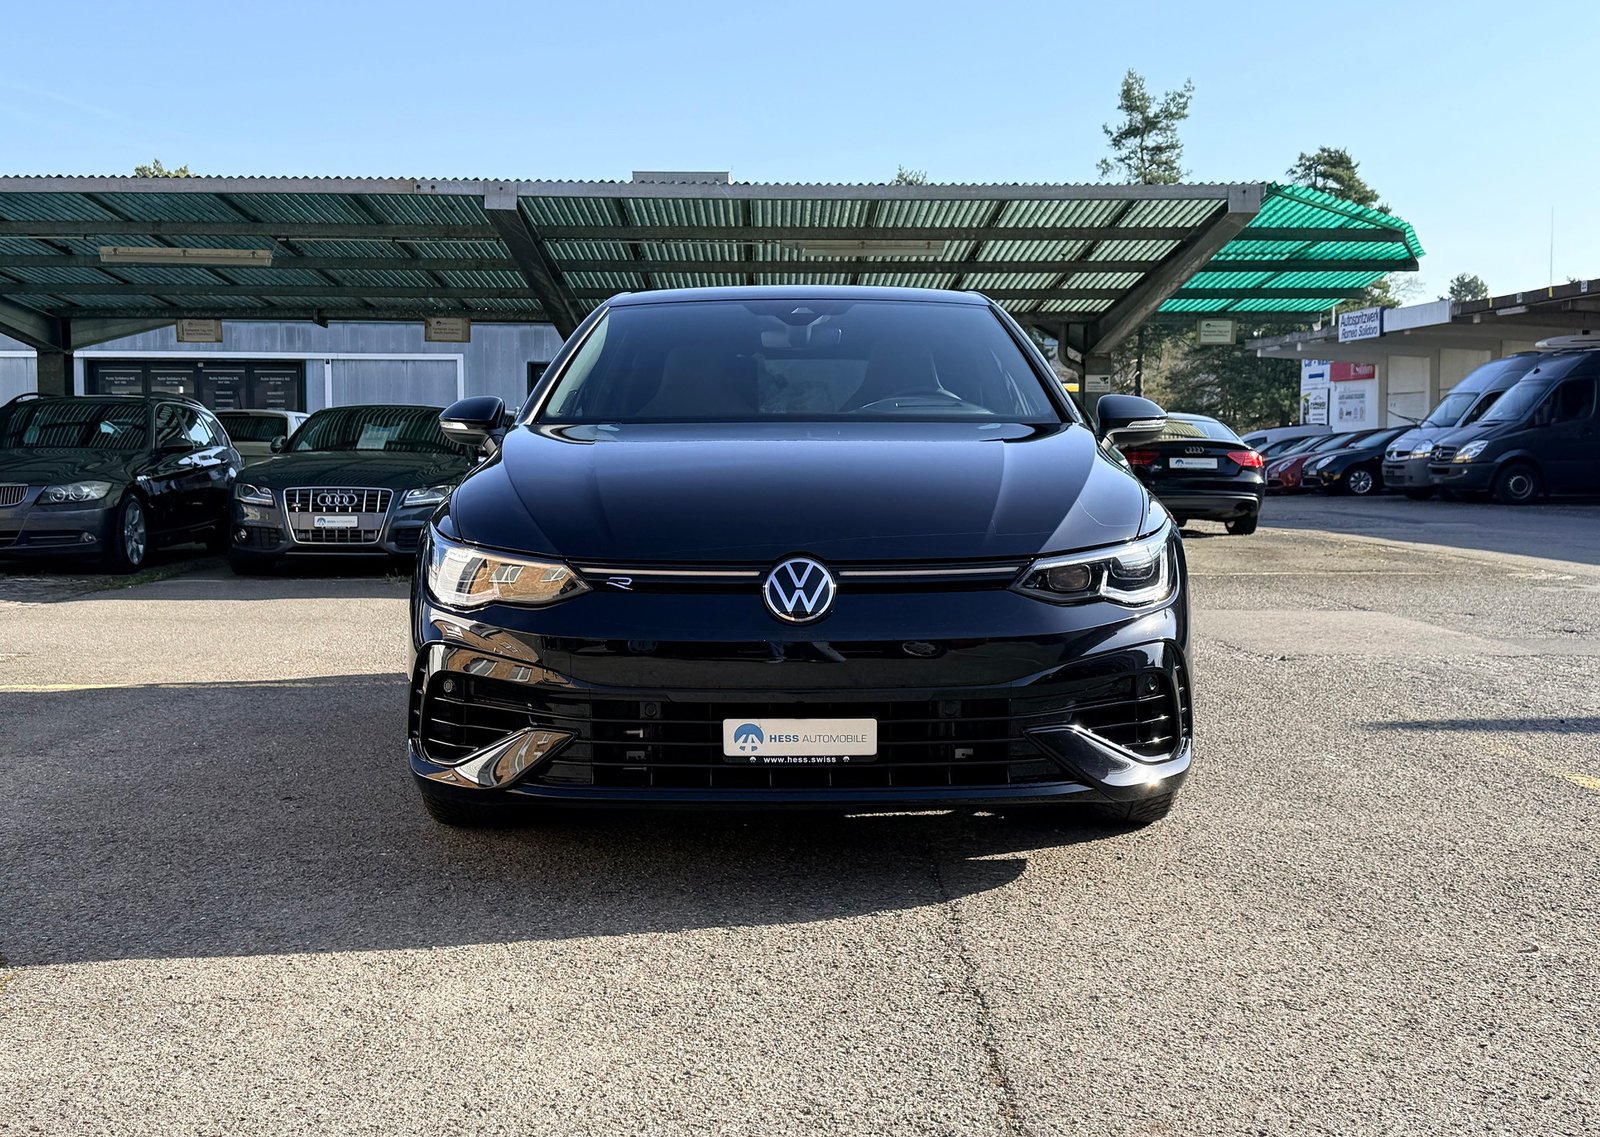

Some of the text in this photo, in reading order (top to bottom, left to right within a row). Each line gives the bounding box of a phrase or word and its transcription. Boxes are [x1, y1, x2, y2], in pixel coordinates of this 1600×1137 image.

[1340, 308, 1379, 327] Autospritzwerk
[1341, 325, 1378, 340] Romeo Solidoro
[769, 734, 867, 743] HESS AUTOMOBILE
